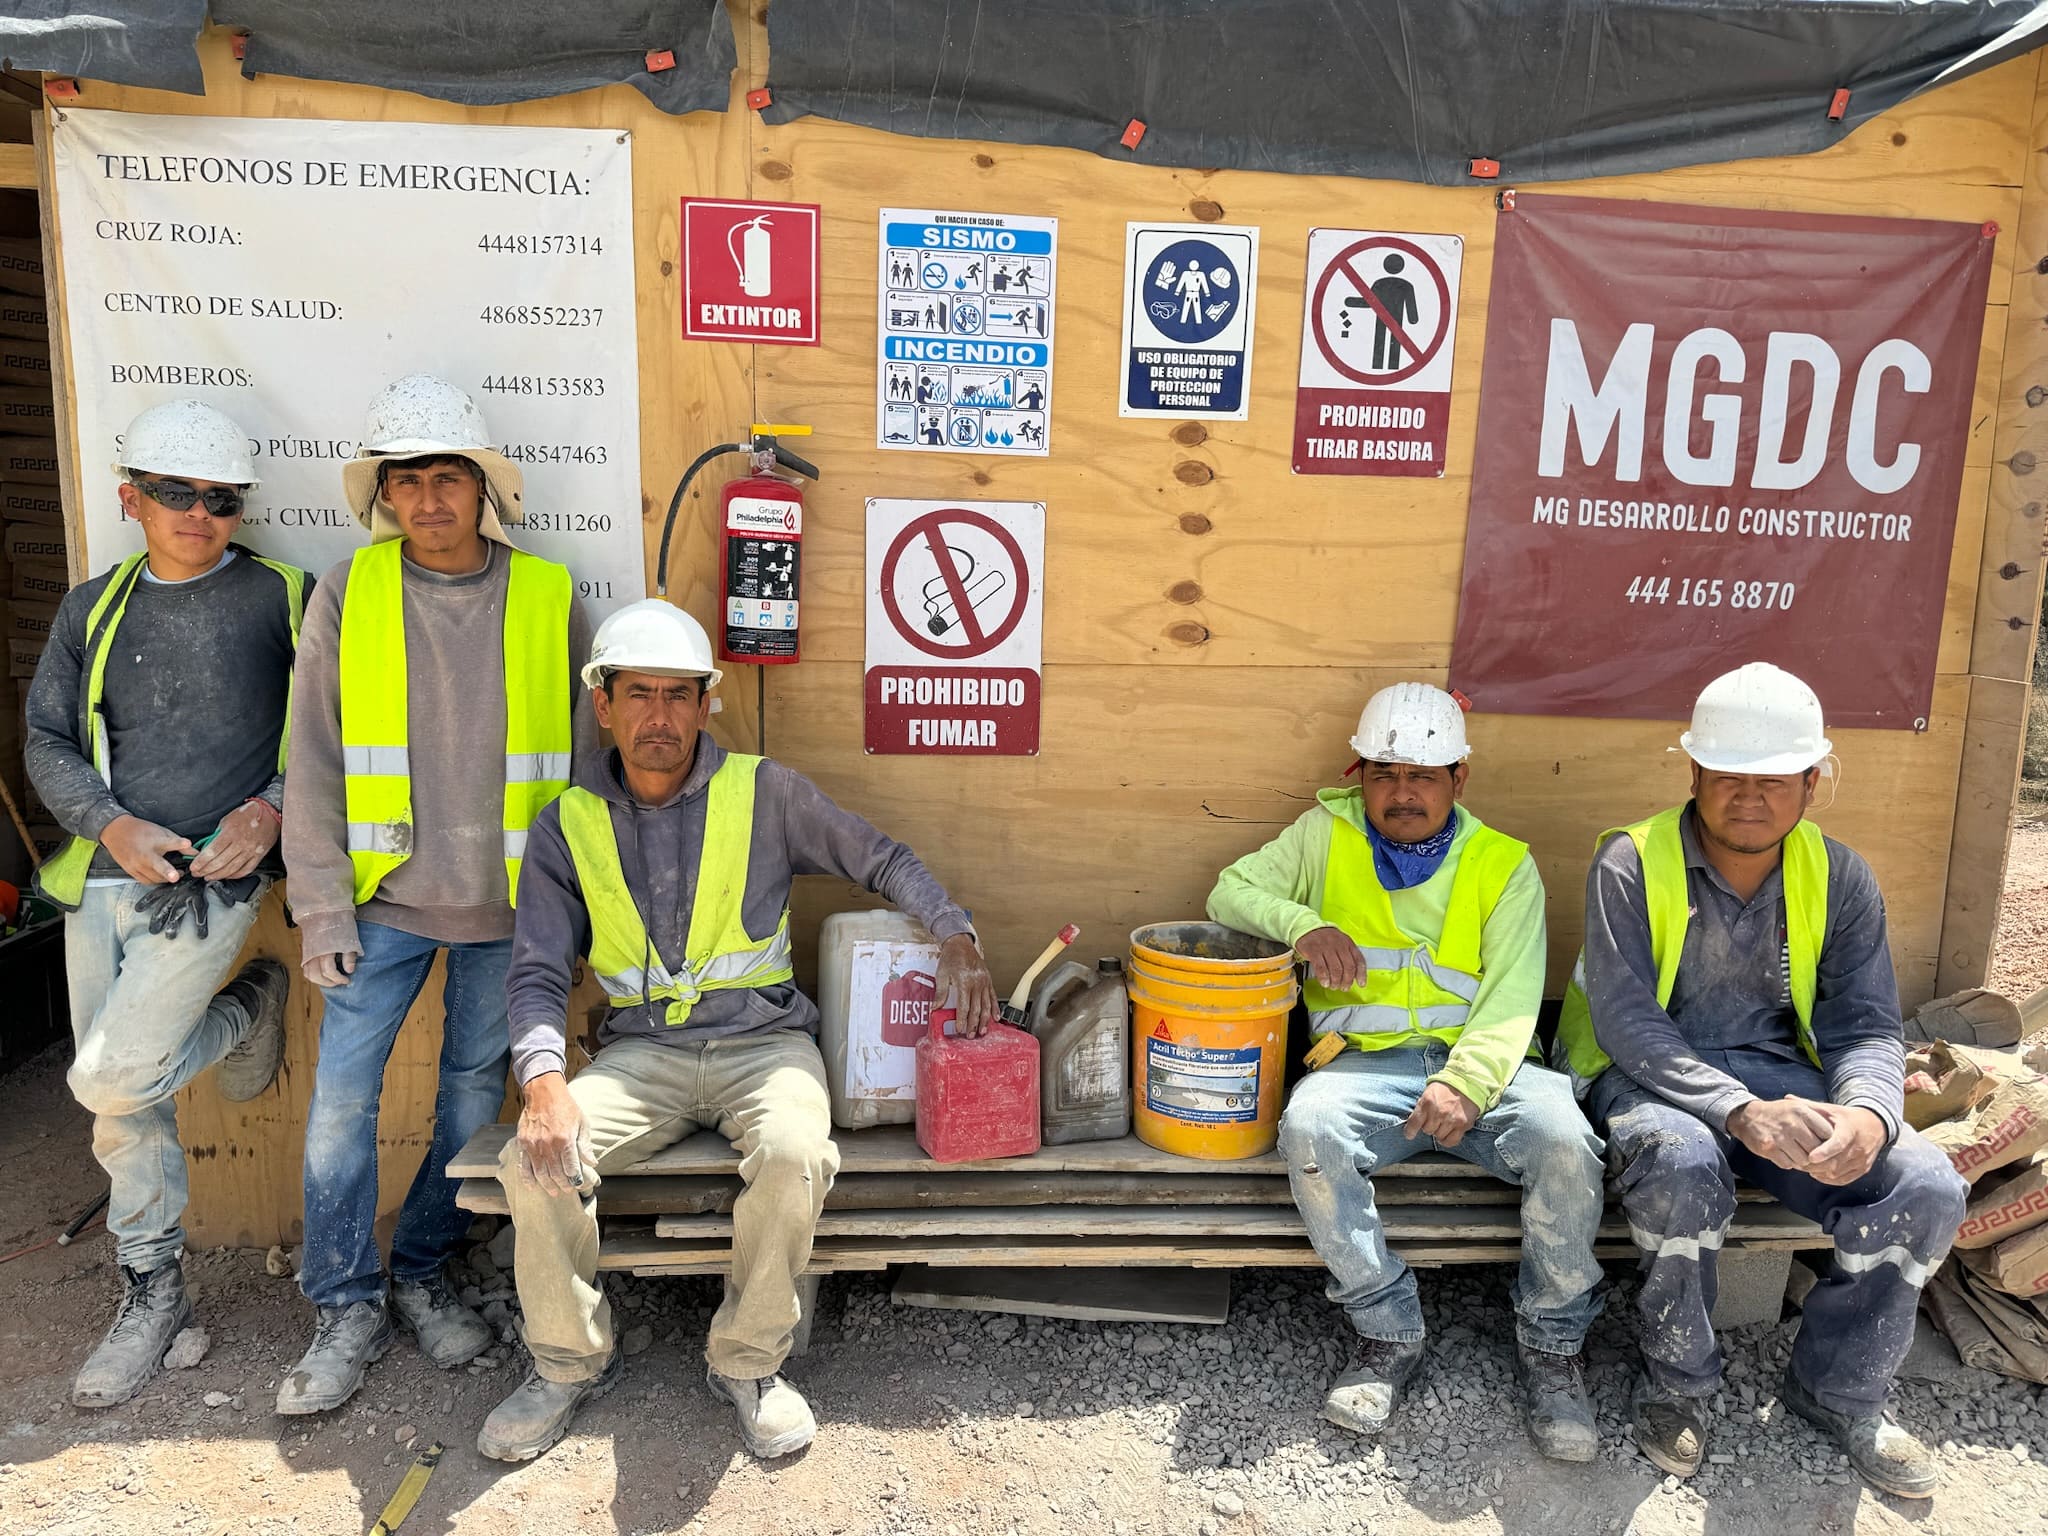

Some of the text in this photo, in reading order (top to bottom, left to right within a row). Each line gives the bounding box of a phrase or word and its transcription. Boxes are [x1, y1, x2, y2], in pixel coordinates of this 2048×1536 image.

[97, 154, 592, 197] TELEFONOS DE EMERGENCIA:
[934, 215, 947, 224] QUE
[948, 216, 968, 224] HACER
[969, 217, 977, 225] EN
[978, 218, 994, 226] CASO
[96, 220, 242, 246] CRUZ ROJA:
[922, 227, 1016, 250] SISMO
[478, 234, 603, 256] 4448157314
[104, 293, 343, 321] CENTRO DE SALUD:
[480, 306, 603, 328] 4868552237
[701, 304, 801, 329] EXTINTOR
[894, 340, 1036, 365] INCENDIO
[1138, 351, 1236, 366] USO OBLIGATORIO
[111, 364, 253, 387] BOMBEROS:
[1150, 367, 1224, 381] DE EQUIPO DE
[481, 376, 605, 397] 4448153583
[1150, 380, 1220, 394] PROTECCION
[1158, 394, 1211, 407] PERSONAL
[1537, 318, 1932, 494] MGDC
[1319, 404, 1426, 430] PROHIBIDO
[500, 444, 607, 464] 448547463
[1306, 438, 1433, 462] TIRAR BASURA
[280, 508, 350, 527] CIVIL:
[736, 514, 782, 524] Philadelphia
[758, 506, 783, 515] Grupo
[1533, 496, 1912, 542] MG DESARROLLO CONSTRUCTOR
[500, 512, 611, 532] 48311260
[580, 581, 614, 598] 911
[1625, 576, 1795, 610] 444 165 8870
[881, 676, 1025, 706] PROHIBIDO
[908, 720, 996, 746] FUMAR
[890, 1000, 932, 1025] DIESE
[1152, 1042, 1170, 1054] Acril
[1201, 1052, 1228, 1062] Super
